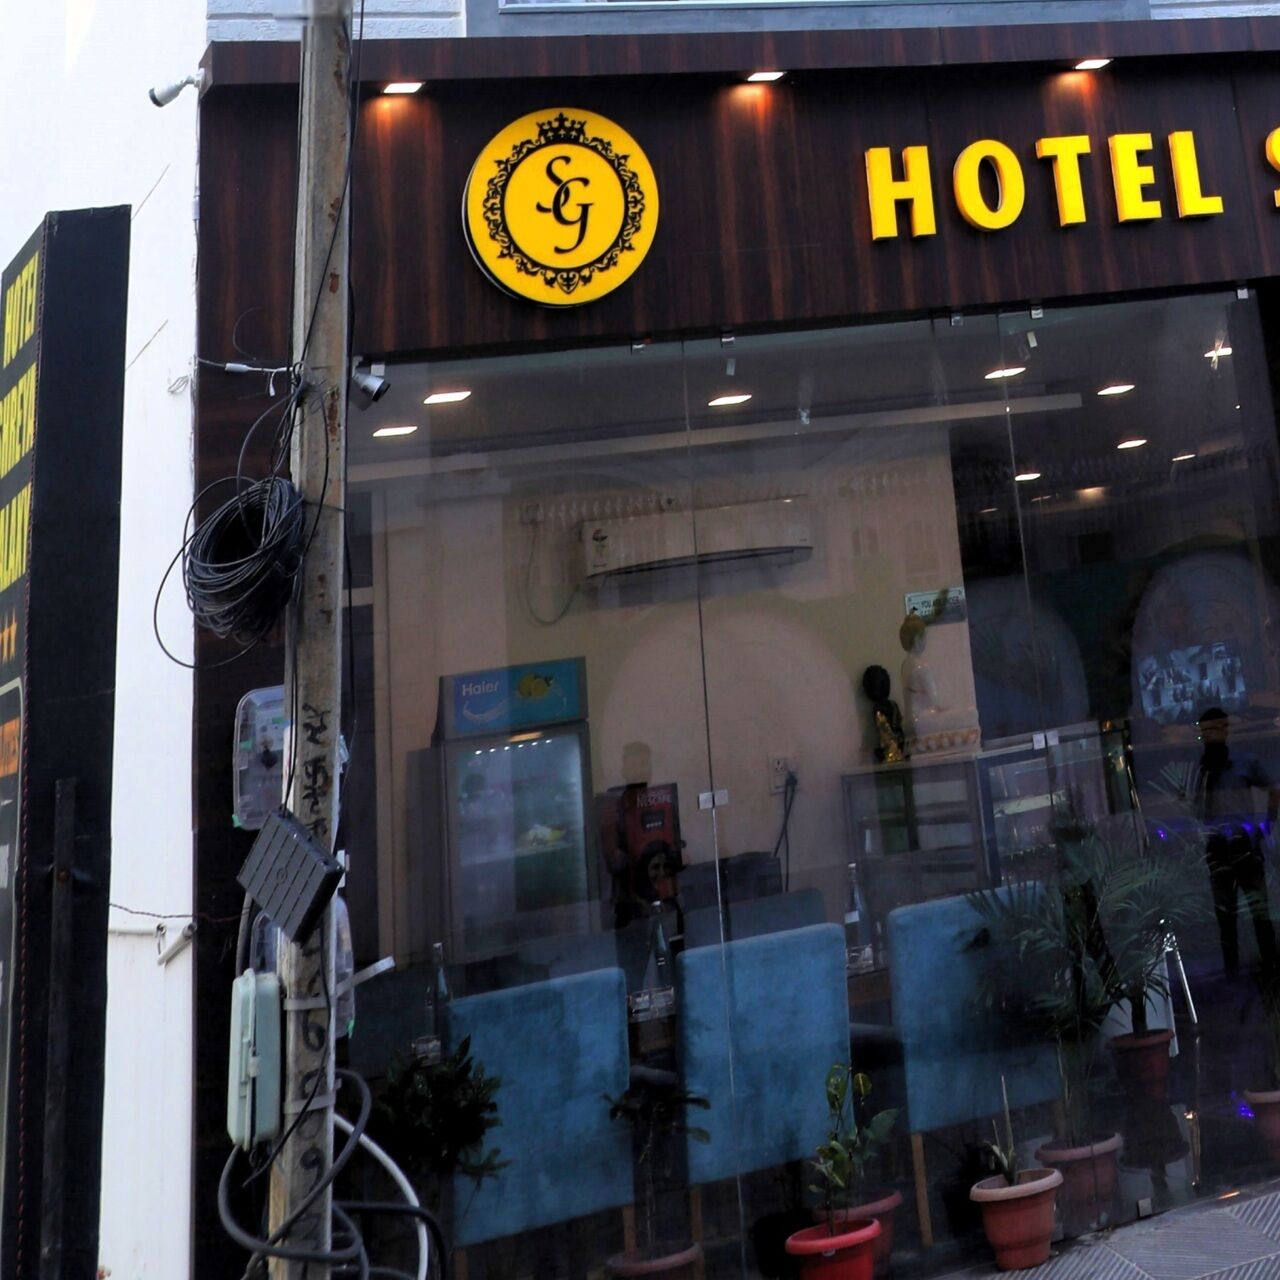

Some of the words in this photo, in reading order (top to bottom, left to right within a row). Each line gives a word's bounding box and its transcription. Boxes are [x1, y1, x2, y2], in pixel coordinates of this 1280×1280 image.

[865, 130, 1225, 240] HOTEL
[0, 481, 32, 593] ALAXY
[462, 680, 500, 697] Haier
